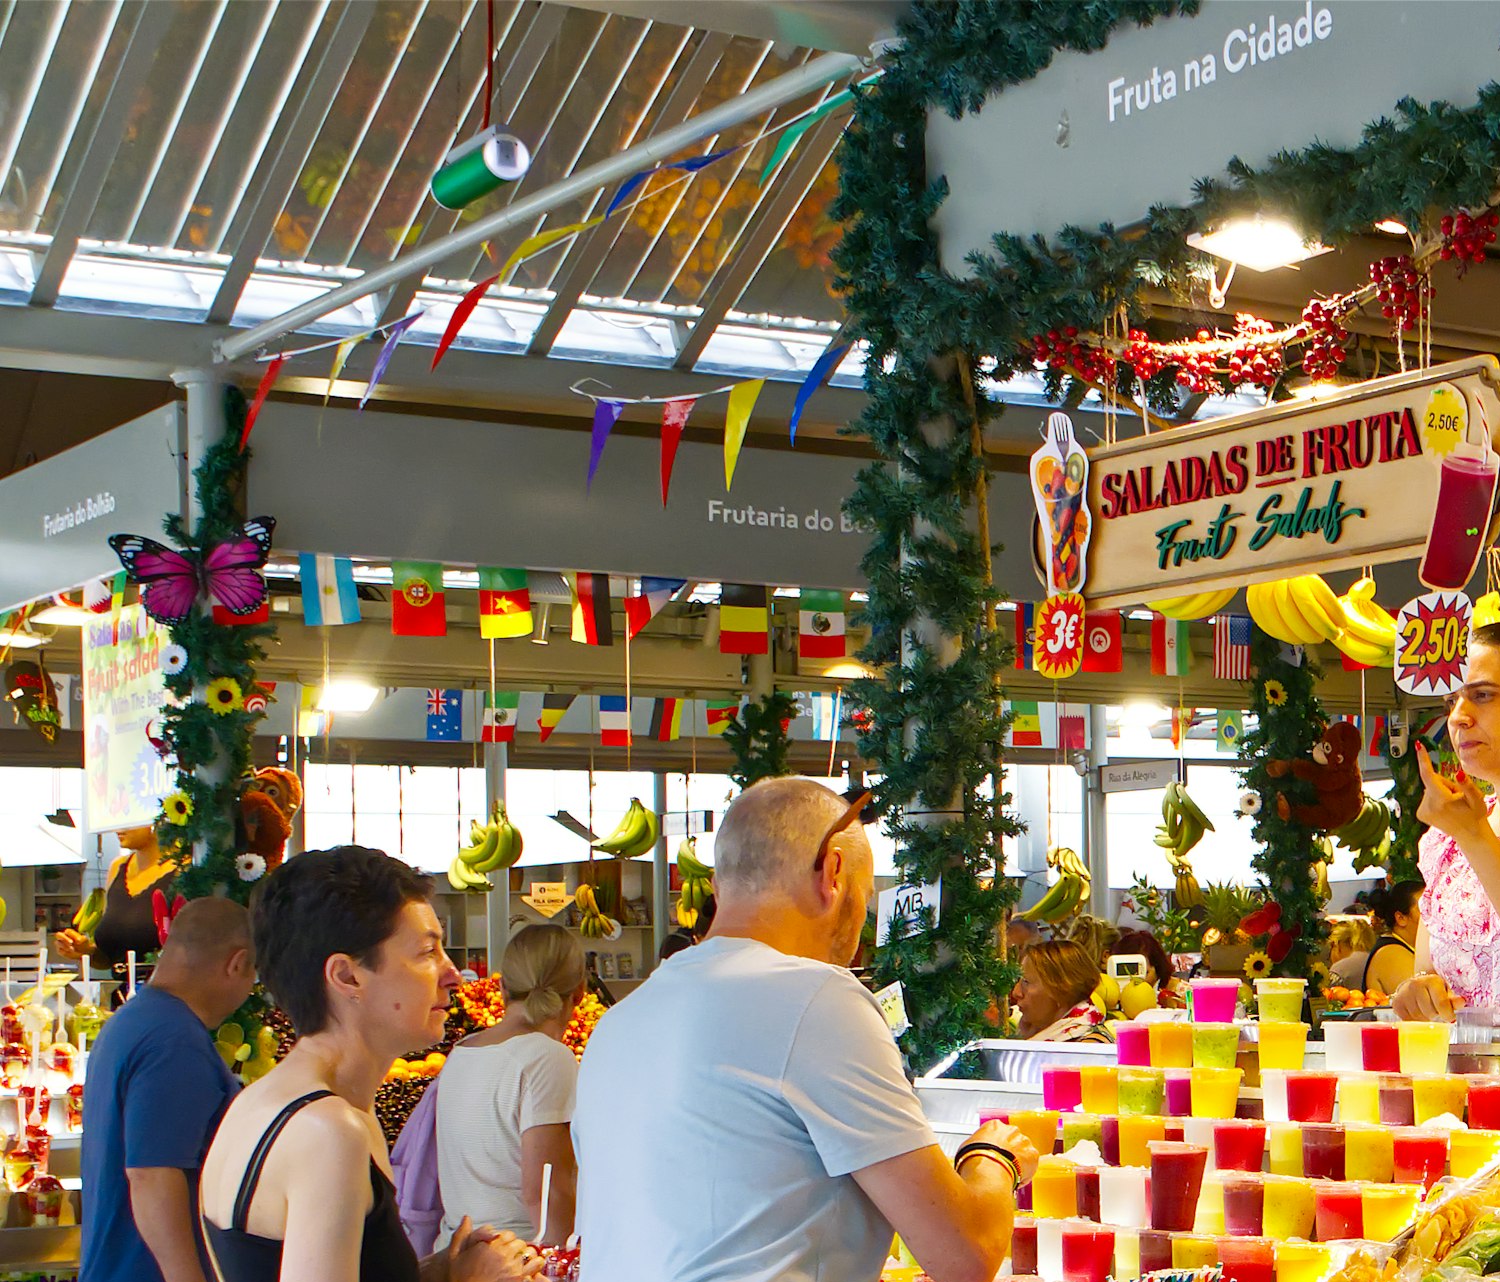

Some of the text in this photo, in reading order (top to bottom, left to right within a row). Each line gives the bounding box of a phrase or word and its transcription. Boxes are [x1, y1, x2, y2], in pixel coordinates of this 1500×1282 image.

[1108, 1, 1333, 122] Fruta na Cidade
[1427, 411, 1460, 432] 2,50€
[1101, 407, 1423, 519] SALADAS DE FRUTA
[44, 491, 116, 538] Frutaria do Bolhão
[708, 499, 799, 529] Frutaria
[804, 510, 834, 532] do
[1155, 480, 1365, 570] Fruit Salads
[1046, 610, 1080, 654] 3€
[1399, 615, 1470, 669] 2,50€
[88, 636, 160, 700] Fruit salad
[1108, 773, 1122, 783] Rua
